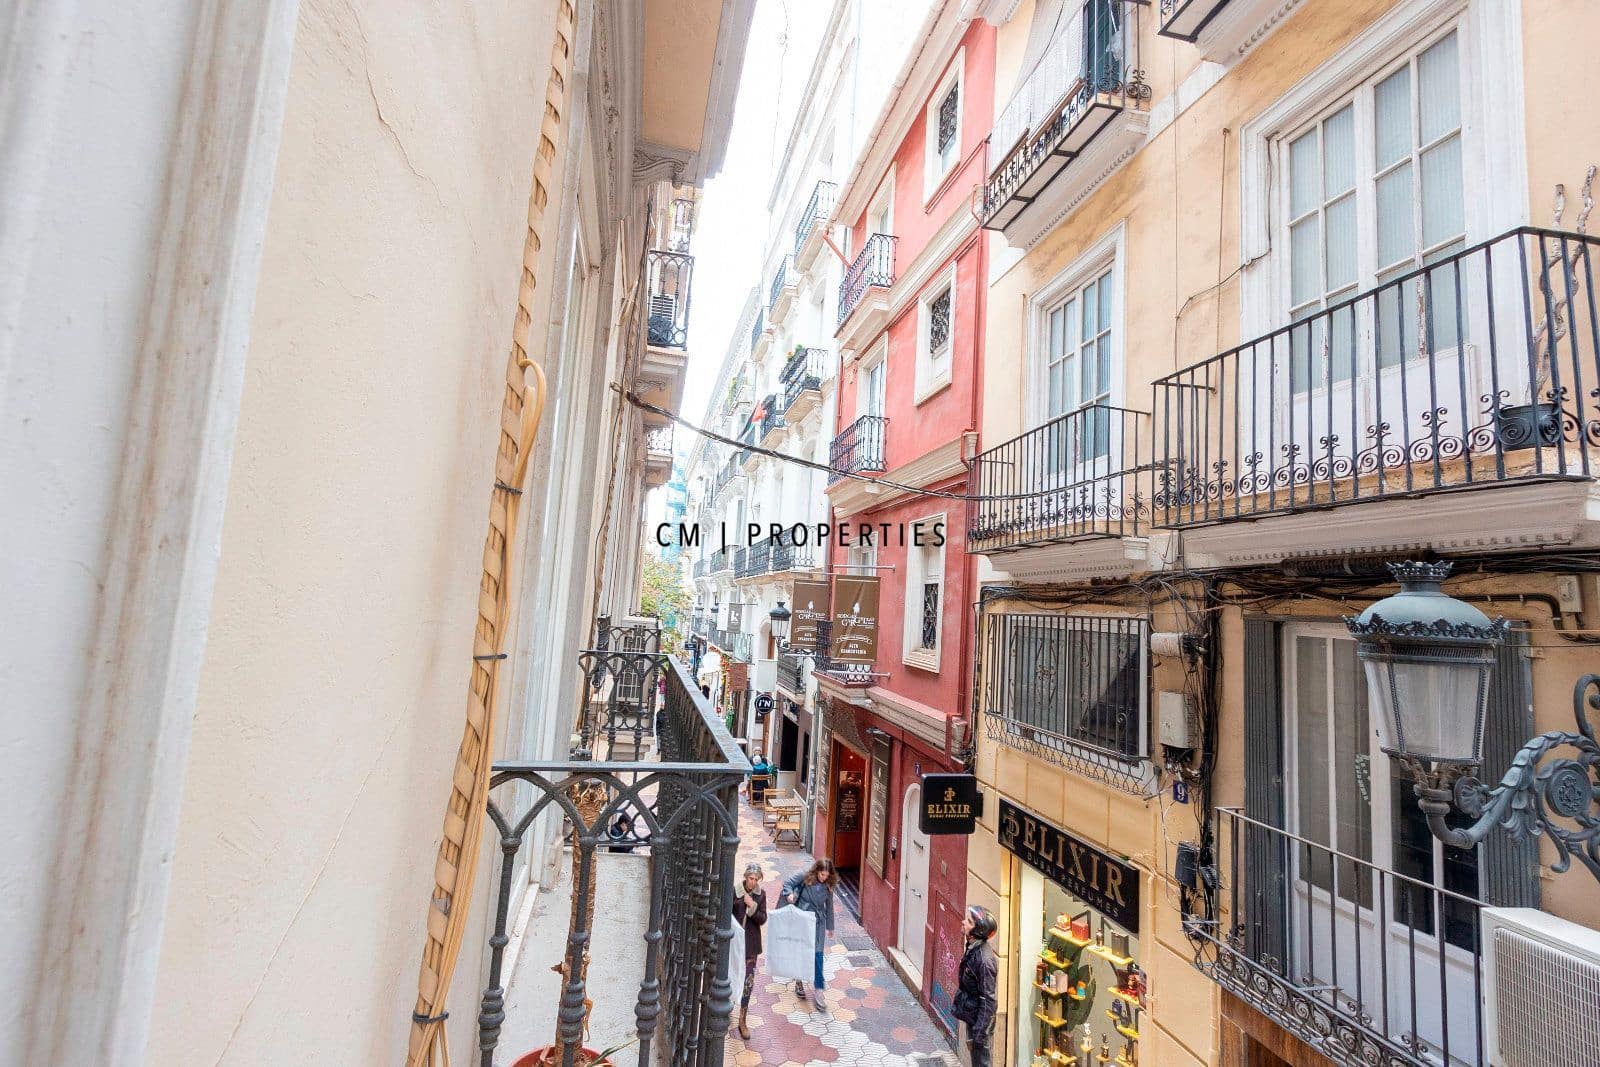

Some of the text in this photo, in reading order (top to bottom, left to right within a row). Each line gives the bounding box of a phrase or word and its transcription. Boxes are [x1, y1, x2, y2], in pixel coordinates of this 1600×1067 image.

[1177, 784, 1185, 801] 9
[927, 804, 971, 814] ELIXIR
[1022, 815, 1126, 907] ELIXIR
